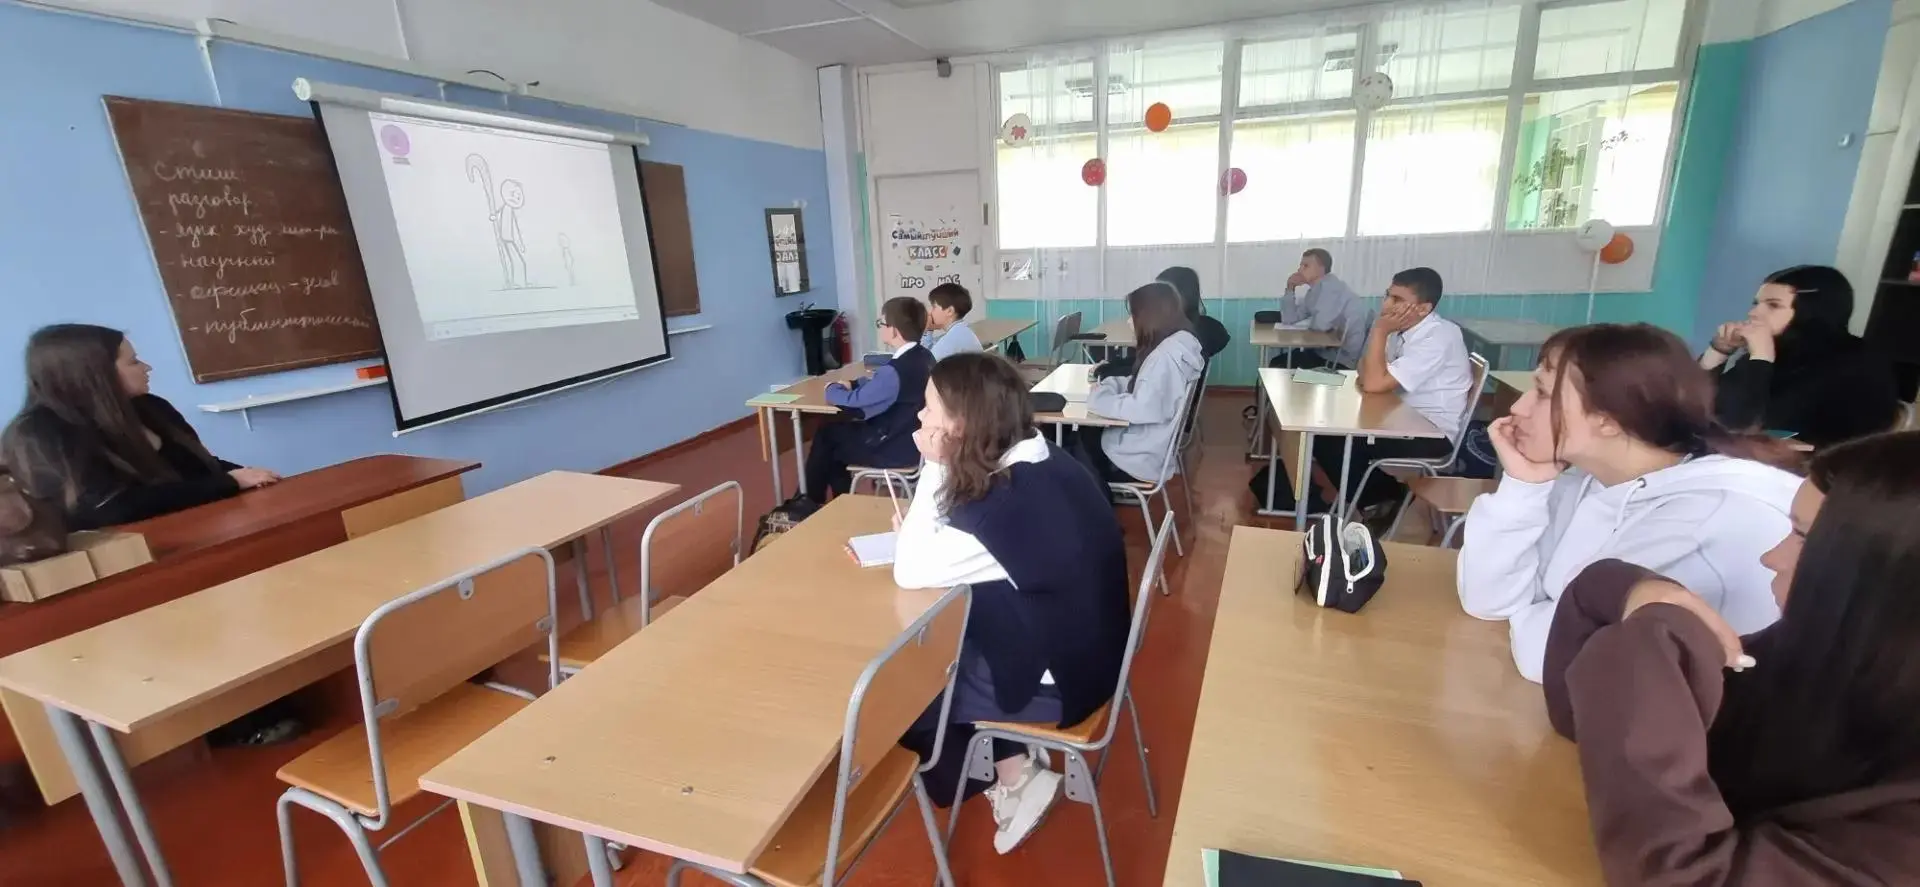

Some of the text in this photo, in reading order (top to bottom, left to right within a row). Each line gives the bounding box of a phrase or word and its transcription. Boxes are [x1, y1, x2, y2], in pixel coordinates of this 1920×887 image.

[909, 246, 946, 257] КЛАСС
[181, 251, 275, 280] научный
[901, 276, 925, 288] ПРО
